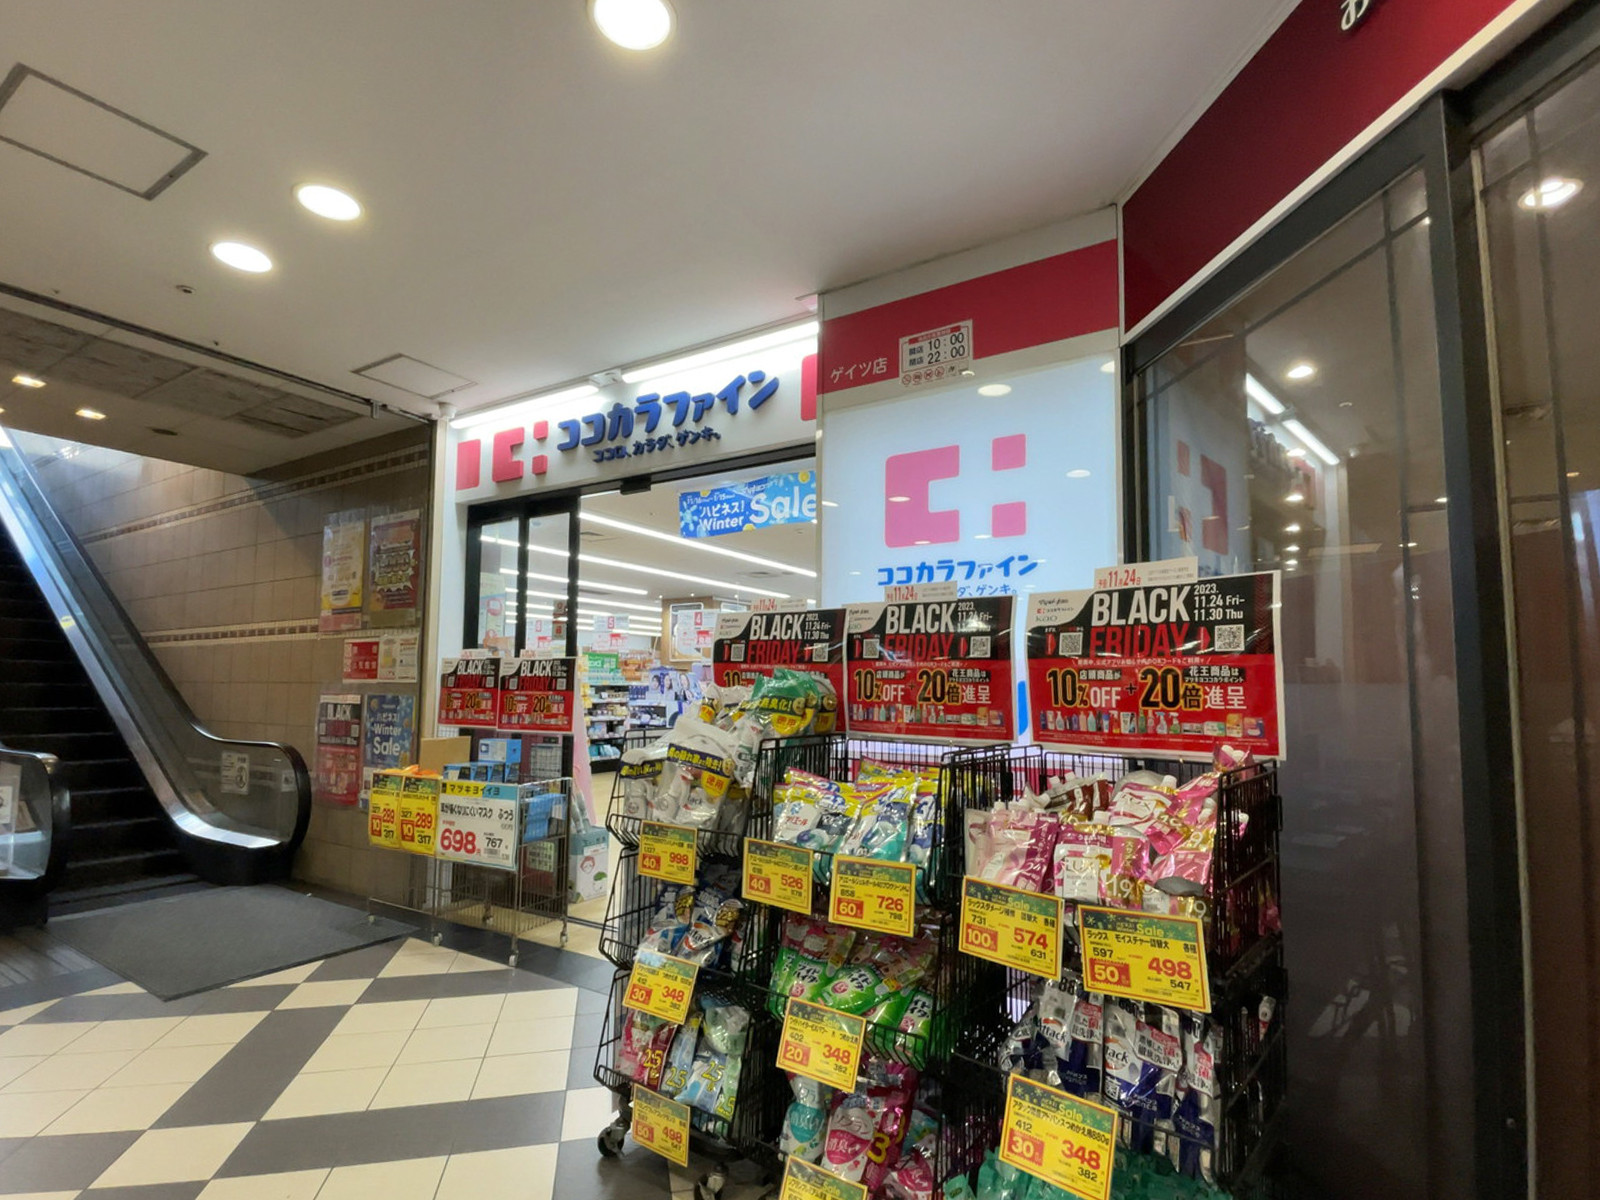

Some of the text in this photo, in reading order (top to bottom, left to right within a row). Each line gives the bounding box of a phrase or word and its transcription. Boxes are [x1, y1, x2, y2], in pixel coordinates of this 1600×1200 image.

[928, 332, 965, 351] 10:00
[927, 345, 966, 364] 22:00
[830, 357, 888, 384] ゲイツ店
[557, 370, 780, 451] ココカラファイン
[700, 500, 745, 518] ハピネス!
[749, 486, 816, 523] Sale
[699, 516, 744, 531] Winter
[878, 555, 1038, 586] ココカラファイン
[1194, 583, 1219, 595] 2023.
[958, 602, 975, 610] 2023.
[1091, 585, 1191, 626] BLACK
[1194, 594, 1223, 608] 11.24
[886, 603, 956, 634] BLACK
[1193, 608, 1244, 621] 11.30 Thu
[750, 614, 805, 640] BLACK
[885, 634, 954, 661] FRIDAY
[1089, 622, 1190, 658] FRIDAY
[747, 640, 801, 664] FRIDAY
[457, 660, 484, 675] BLACK
[521, 661, 553, 676] BLACK
[951, 669, 987, 678] 花王商品は
[1189, 665, 1239, 677] 花王商品は
[882, 685, 905, 702] OFF
[1090, 687, 1121, 708] OFF
[327, 704, 351, 720] BLACK
[374, 723, 401, 736] Winter
[373, 737, 400, 755] Sale
[415, 812, 433, 829] 289
[498, 808, 514, 821] ふつう
[402, 823, 413, 836] 10
[417, 834, 431, 845] 317
[440, 828, 476, 855] 698
[486, 837, 503, 848] 767
[643, 857, 656, 868] 40
[751, 878, 766, 891] 40
[781, 874, 804, 890] 526
[840, 902, 857, 915] 60
[876, 895, 904, 912] 726
[971, 914, 987, 925] 731
[967, 928, 991, 948] 100
[1087, 930, 1108, 940] ラックス
[1137, 923, 1164, 937] Sale
[1014, 927, 1048, 950] 574
[1030, 949, 1046, 959] 631
[1092, 947, 1114, 958] 597
[1094, 964, 1119, 983] 50
[1148, 957, 1192, 980] 498
[1170, 980, 1191, 991] 547
[632, 988, 646, 1001] 30
[662, 985, 685, 1003] 348
[786, 1046, 803, 1061] 20
[822, 1044, 851, 1065] 348
[1058, 1104, 1084, 1122] Sale
[1015, 1119, 1033, 1133] 412
[662, 1126, 683, 1144] 498
[1011, 1135, 1035, 1159] 30
[1061, 1139, 1101, 1170] 348
[1077, 1166, 1098, 1182] 382
